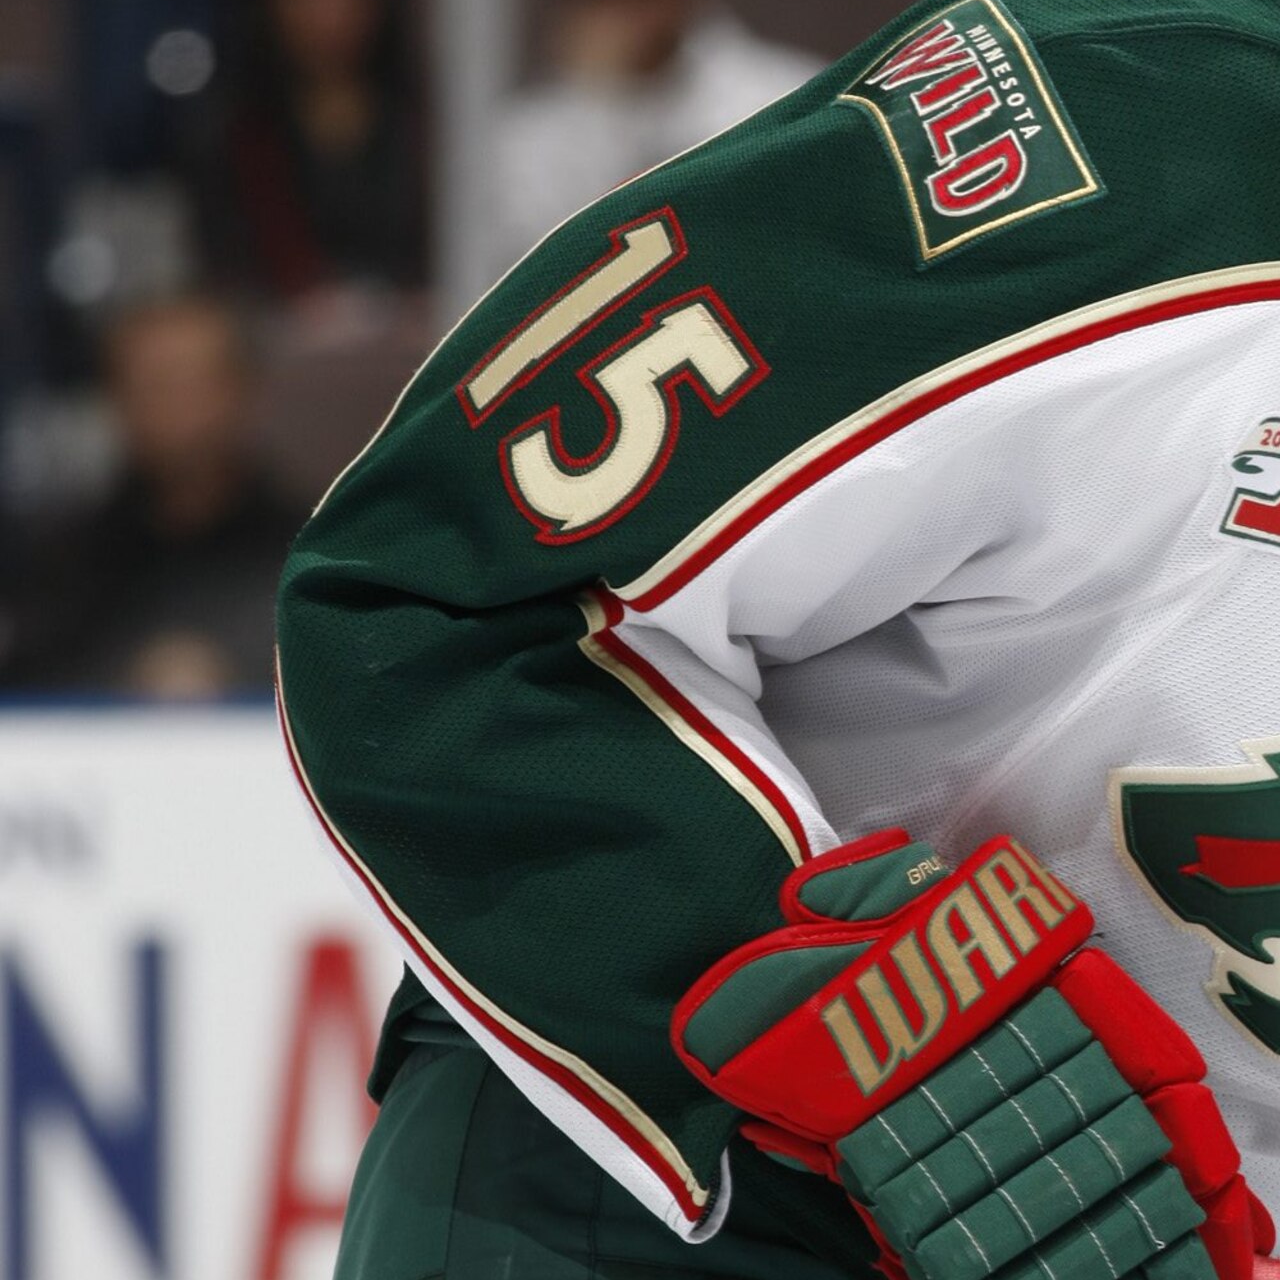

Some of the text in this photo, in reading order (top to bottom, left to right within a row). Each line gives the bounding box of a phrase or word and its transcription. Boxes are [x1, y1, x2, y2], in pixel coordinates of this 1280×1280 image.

[864, 19, 1027, 217] WILD
[966, 23, 1042, 140] MINNESOTA
[455, 205, 772, 547] 15
